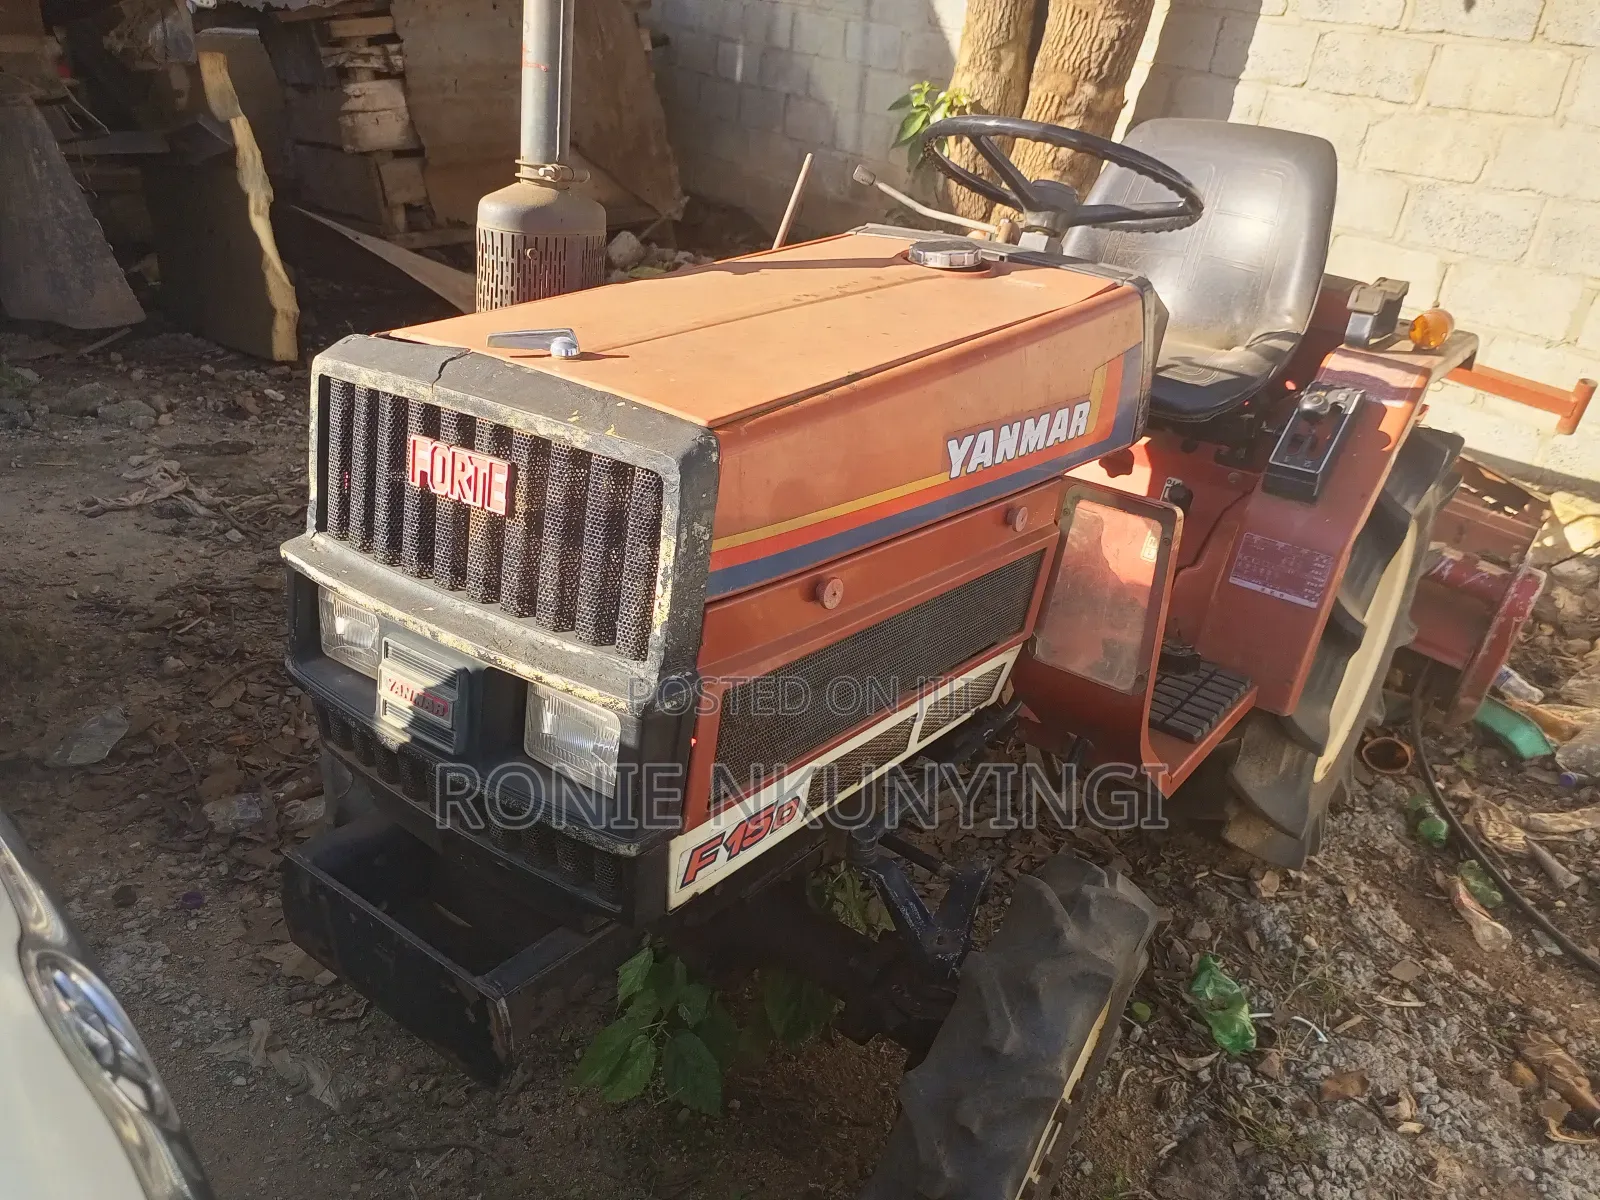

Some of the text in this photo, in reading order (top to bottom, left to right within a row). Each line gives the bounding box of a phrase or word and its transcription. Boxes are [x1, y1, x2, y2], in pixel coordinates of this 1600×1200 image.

[410, 434, 509, 515] FORTE
[947, 400, 1091, 480] YANMAR
[387, 677, 446, 716] YANMAR
[680, 795, 801, 889] F15D
